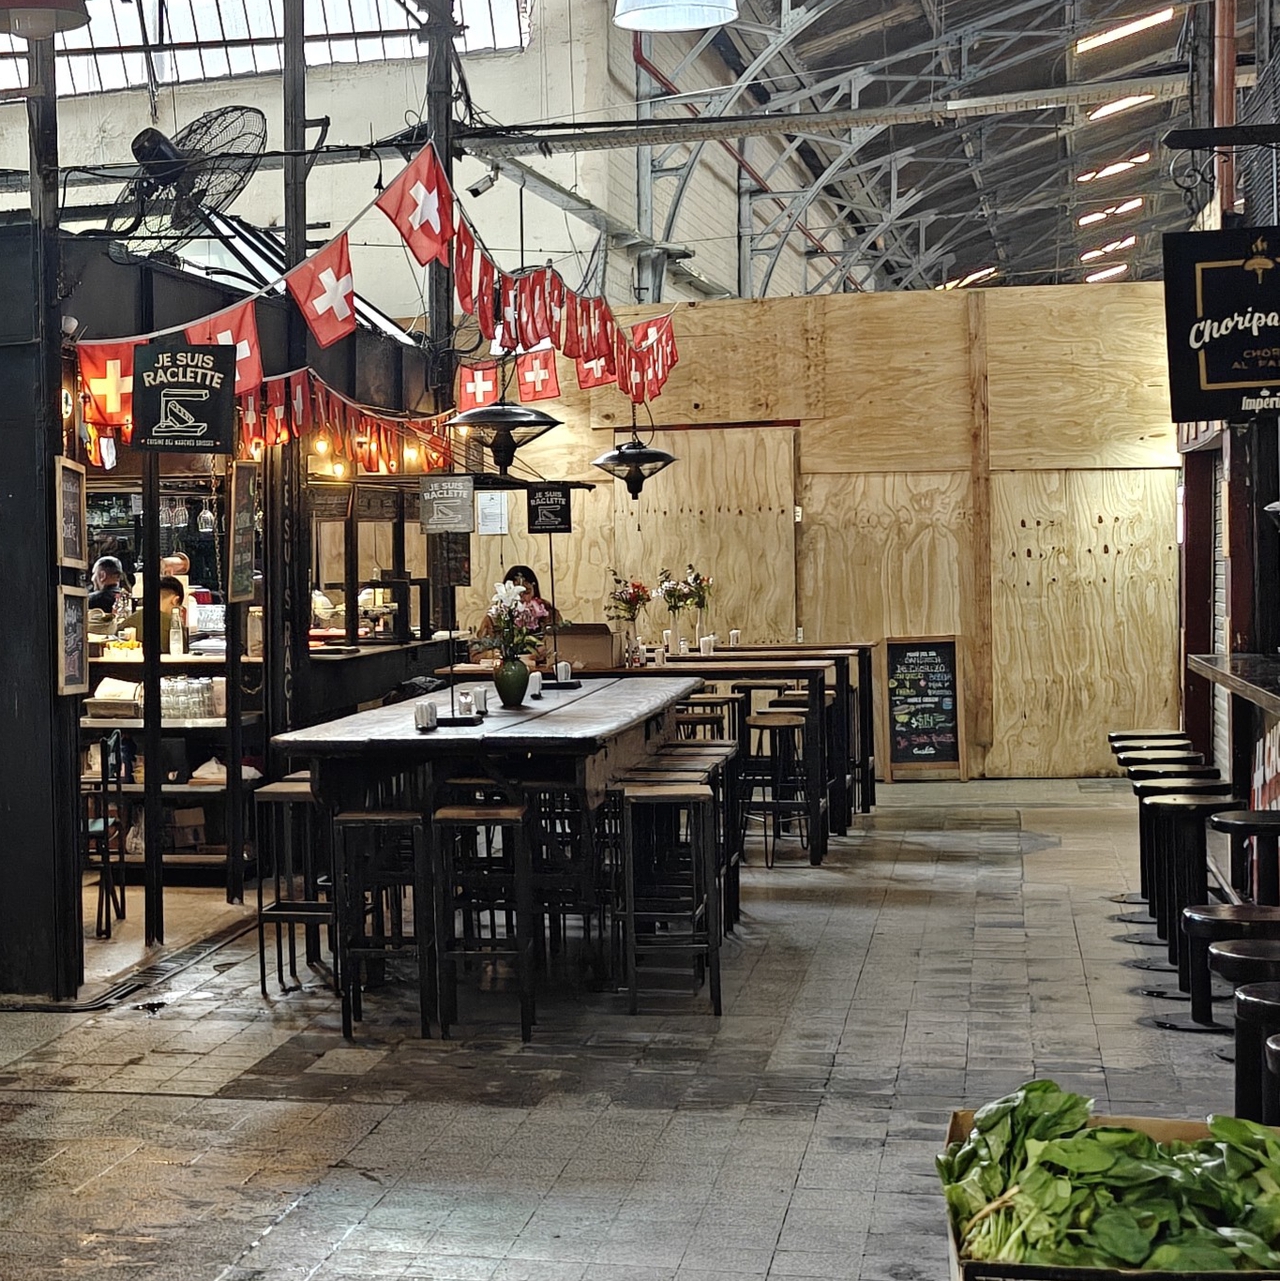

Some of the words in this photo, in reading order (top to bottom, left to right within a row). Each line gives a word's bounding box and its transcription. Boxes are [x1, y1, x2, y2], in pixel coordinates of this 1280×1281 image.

[1189, 306, 1280, 350] Choripa
[154, 352, 172, 368] JE
[176, 352, 214, 368] SUIS
[1258, 359, 1280, 367] PA
[142, 367, 224, 388] RACLETTE
[429, 483, 440, 491] JE
[442, 482, 464, 490] SUIS
[423, 489, 469, 501] RACLETTE
[530, 497, 567, 506] RACLETTE
[284, 621, 293, 730] RACL
